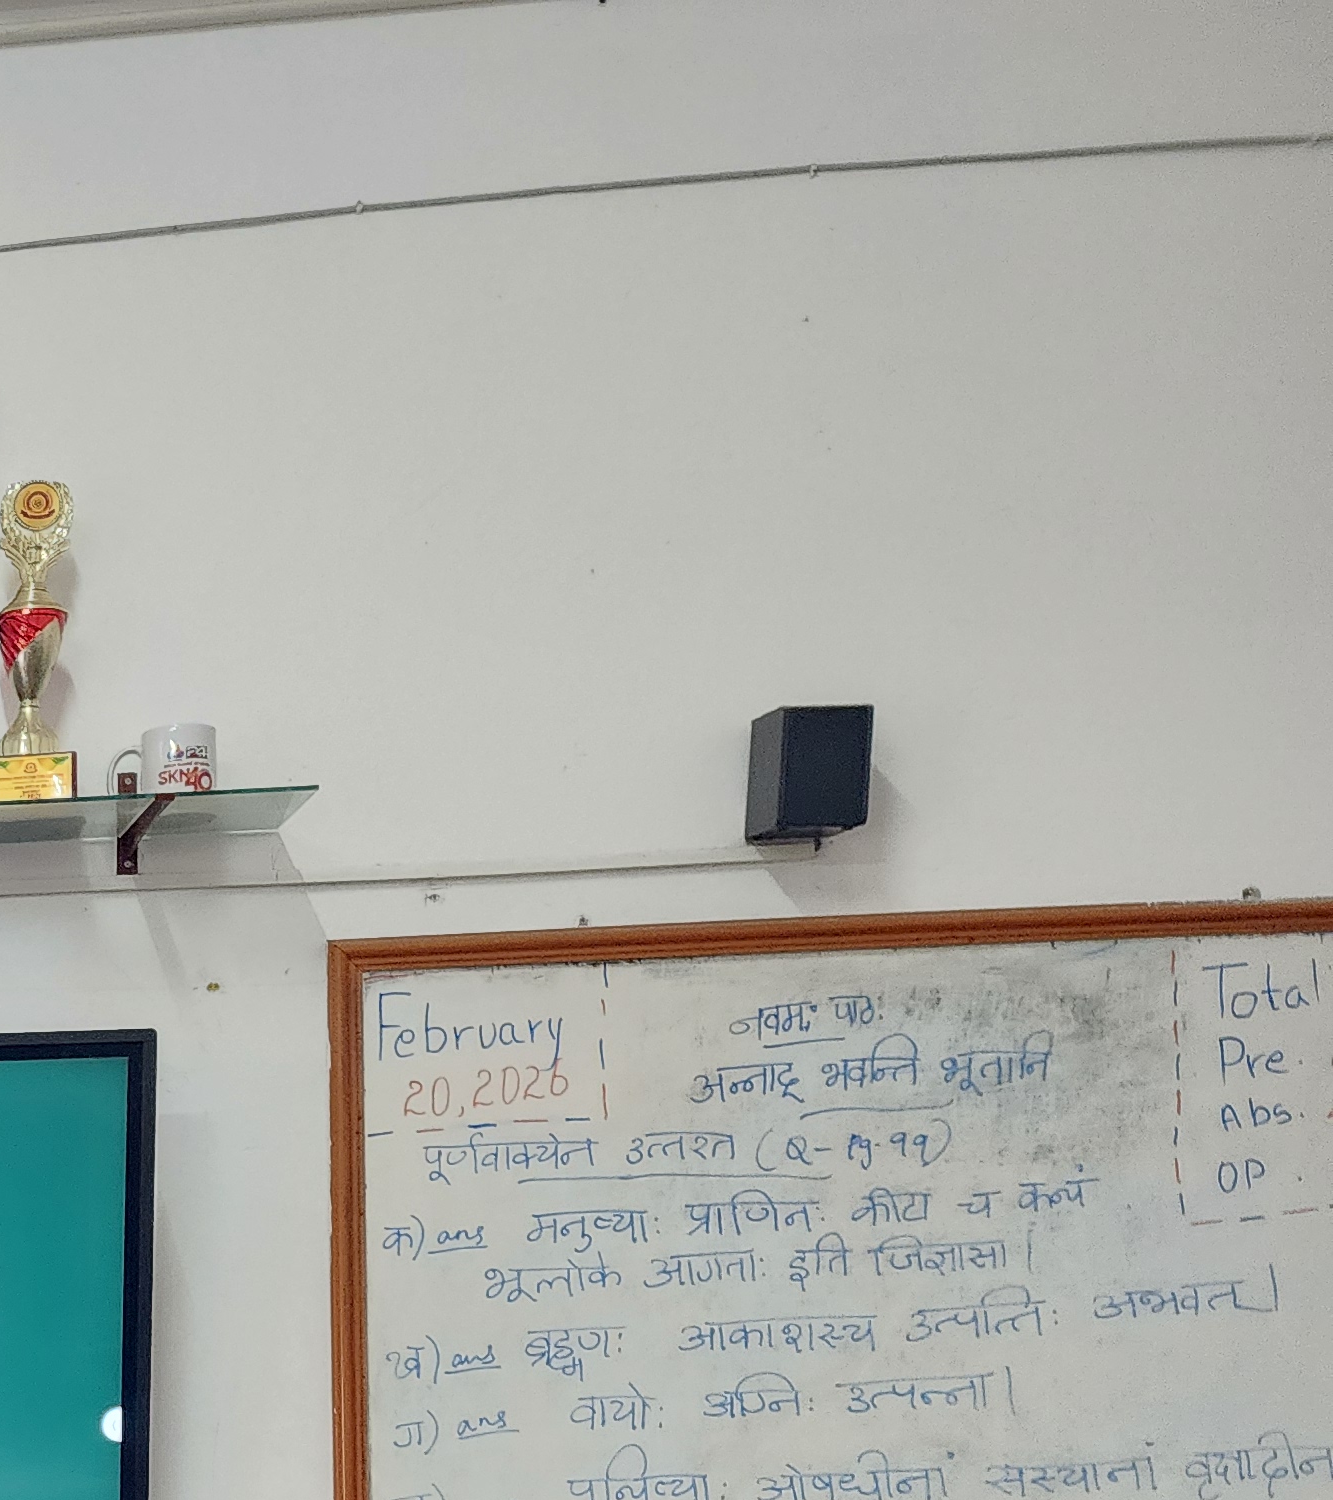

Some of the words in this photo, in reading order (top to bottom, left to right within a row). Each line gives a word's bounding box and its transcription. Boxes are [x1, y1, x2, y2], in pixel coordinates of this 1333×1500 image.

[1202, 957, 1320, 1019] Total
[377, 990, 564, 1072] February
[821, 1033, 921, 1092] भवन्ति
[940, 1029, 1054, 1097] भूतानि
